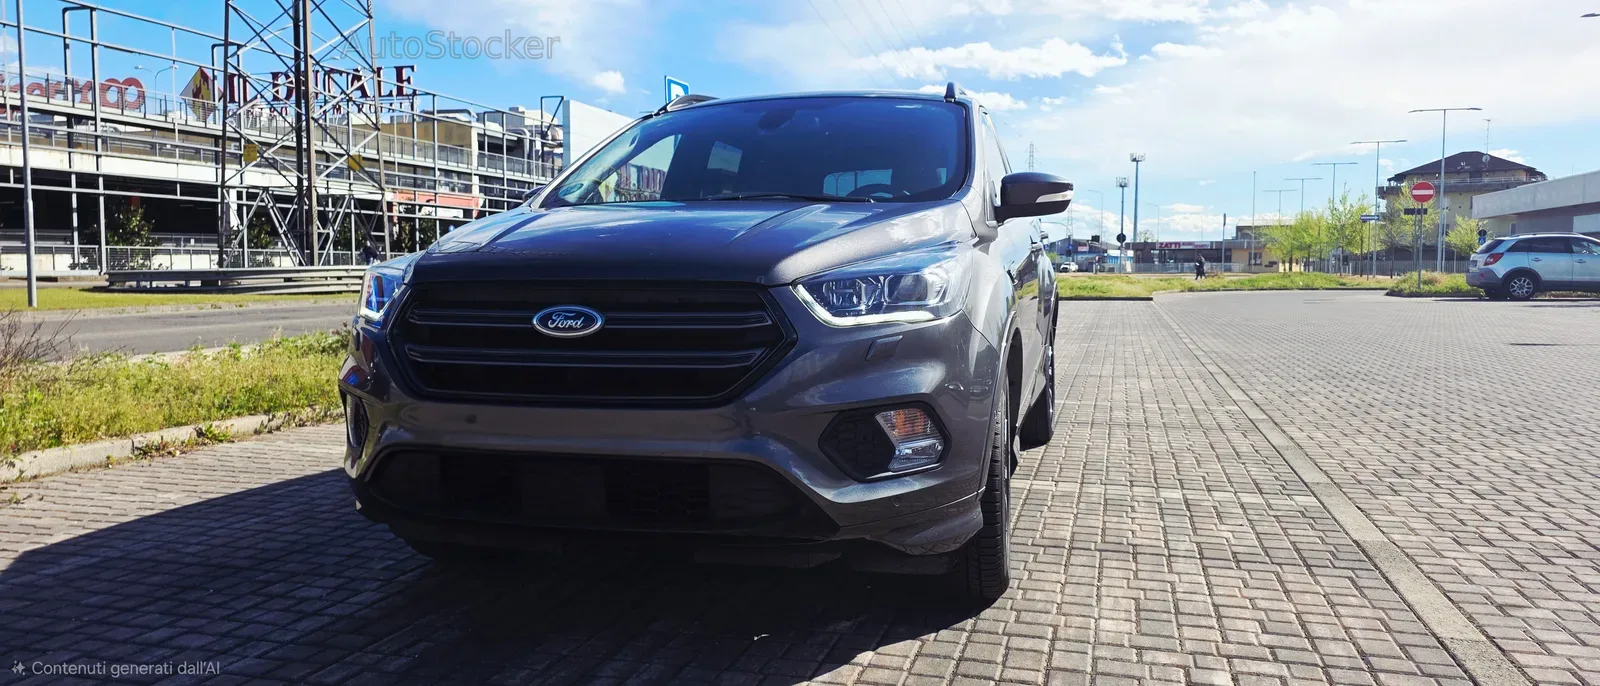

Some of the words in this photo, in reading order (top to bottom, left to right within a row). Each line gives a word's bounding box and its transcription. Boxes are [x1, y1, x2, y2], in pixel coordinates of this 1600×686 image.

[227, 73, 259, 104] IL
[1158, 241, 1181, 249] ZATTI
[547, 311, 585, 329] Ford
